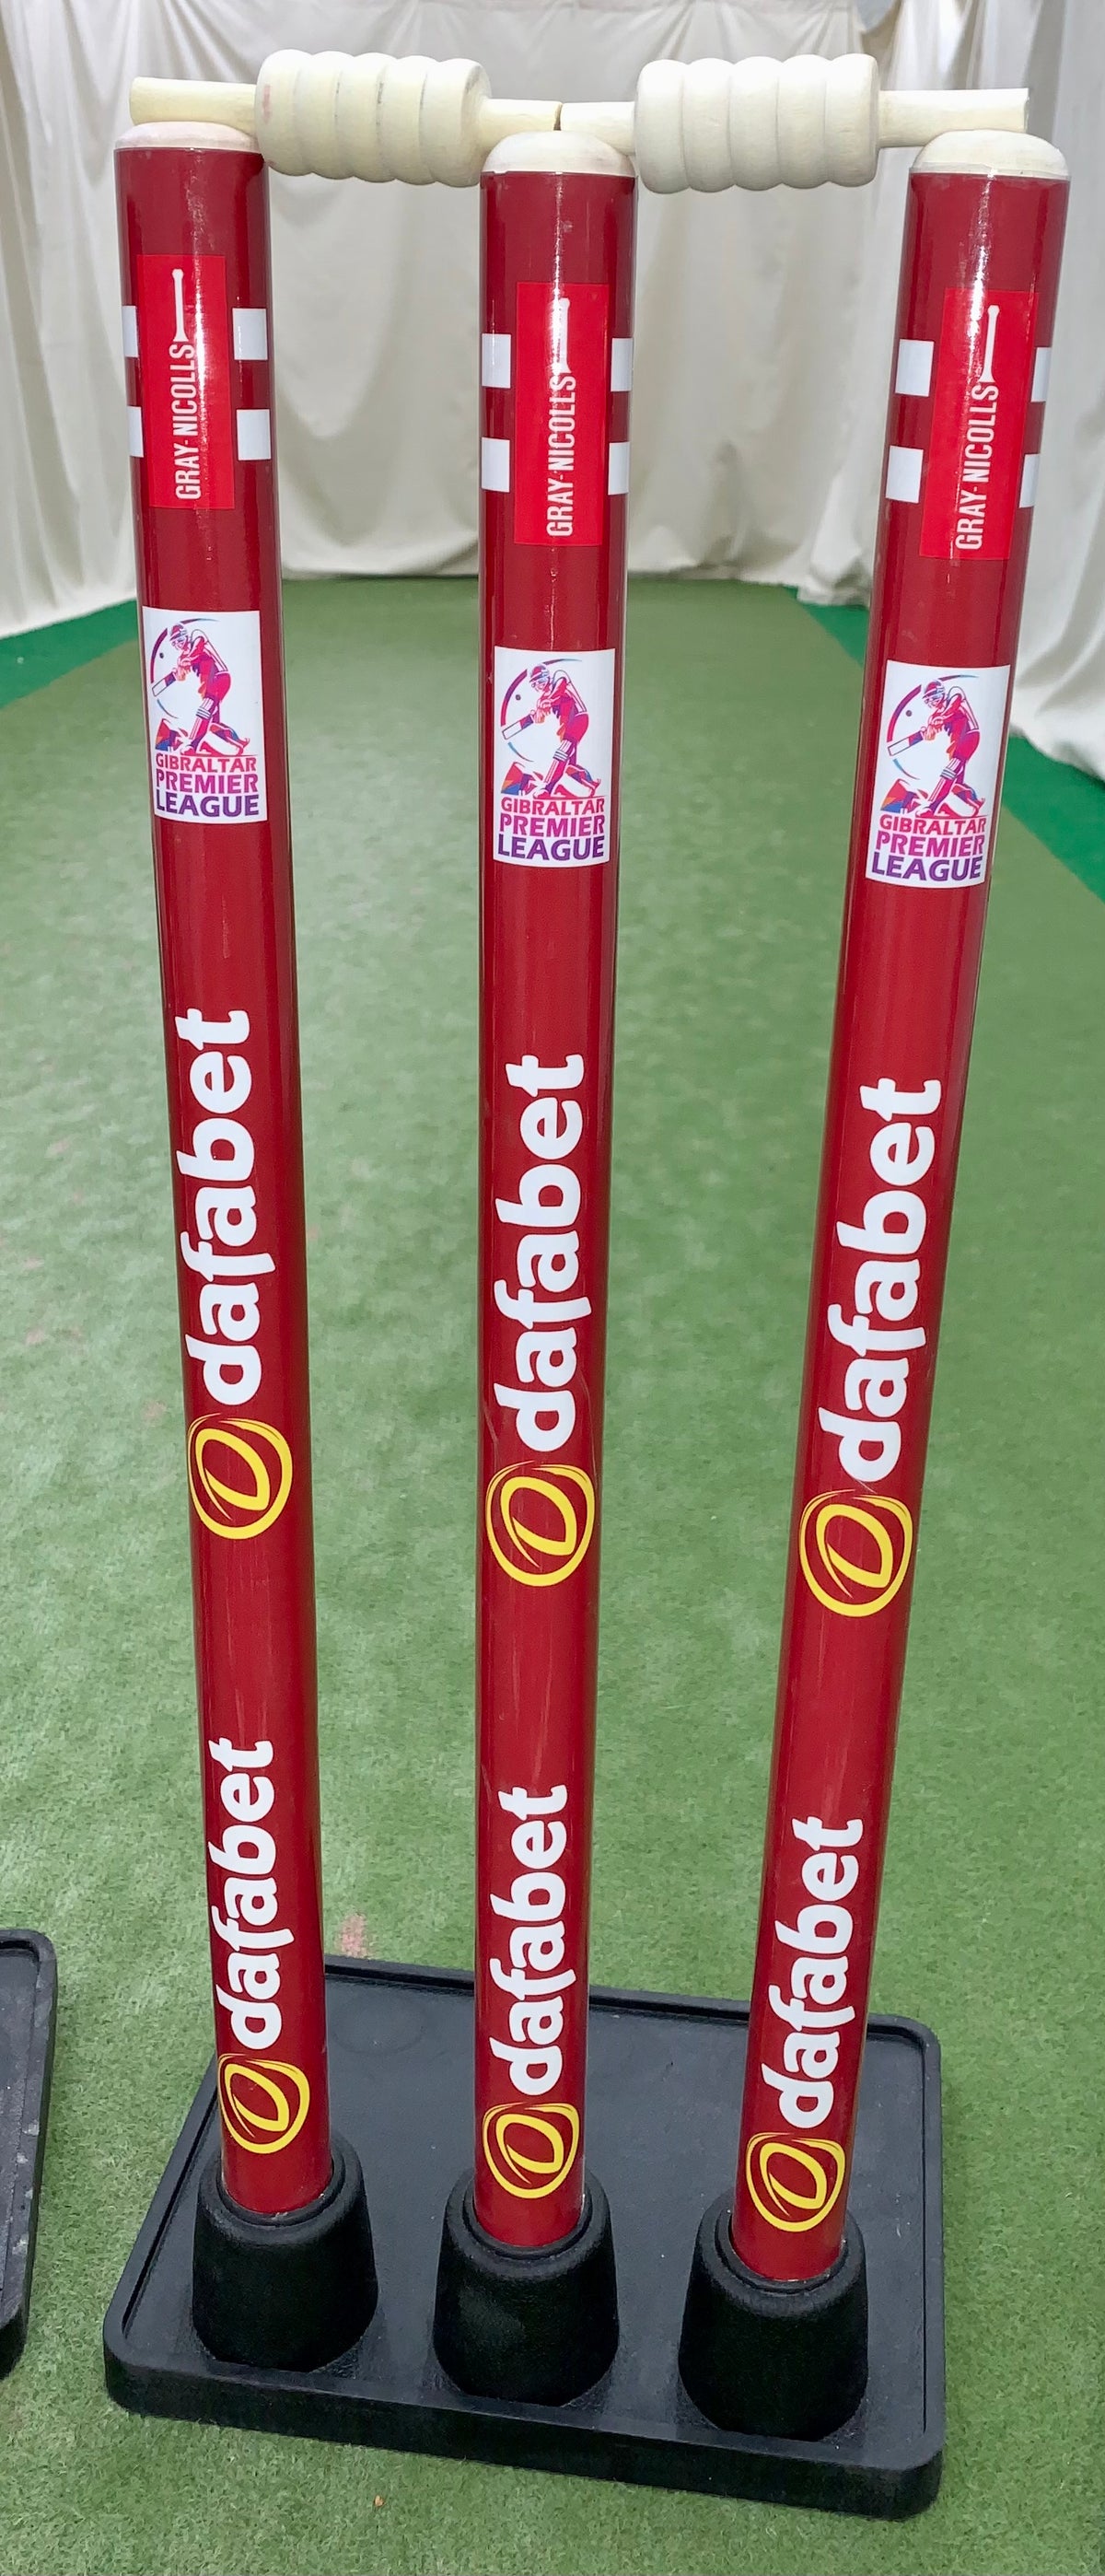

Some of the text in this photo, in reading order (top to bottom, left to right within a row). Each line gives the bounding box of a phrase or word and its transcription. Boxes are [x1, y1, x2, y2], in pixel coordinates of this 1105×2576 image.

[169, 342, 199, 501] GRAY-NICOLLS
[546, 375, 576, 537] GRAY-NICOLLS
[954, 384, 999, 551] GRAY-NICOLLS
[156, 752, 257, 773] GIBRALTAR
[156, 768, 259, 794] PREMIER
[157, 788, 260, 818] LEAGUE
[500, 797, 605, 816] GIBRALTAR
[497, 833, 605, 861] LEAGUE
[499, 812, 605, 837] PREMIER
[871, 851, 983, 881] LEAGUE
[876, 830, 985, 857] PREMIER
[879, 813, 987, 835] GIBRALTAR
[175, 1008, 276, 1406] dafabet
[494, 1054, 591, 1453] dafabet
[819, 1077, 942, 1483] dafabet
[208, 1737, 295, 2051] dafabet
[489, 1784, 576, 2096] dafabet
[761, 1815, 864, 2130] dafabet
